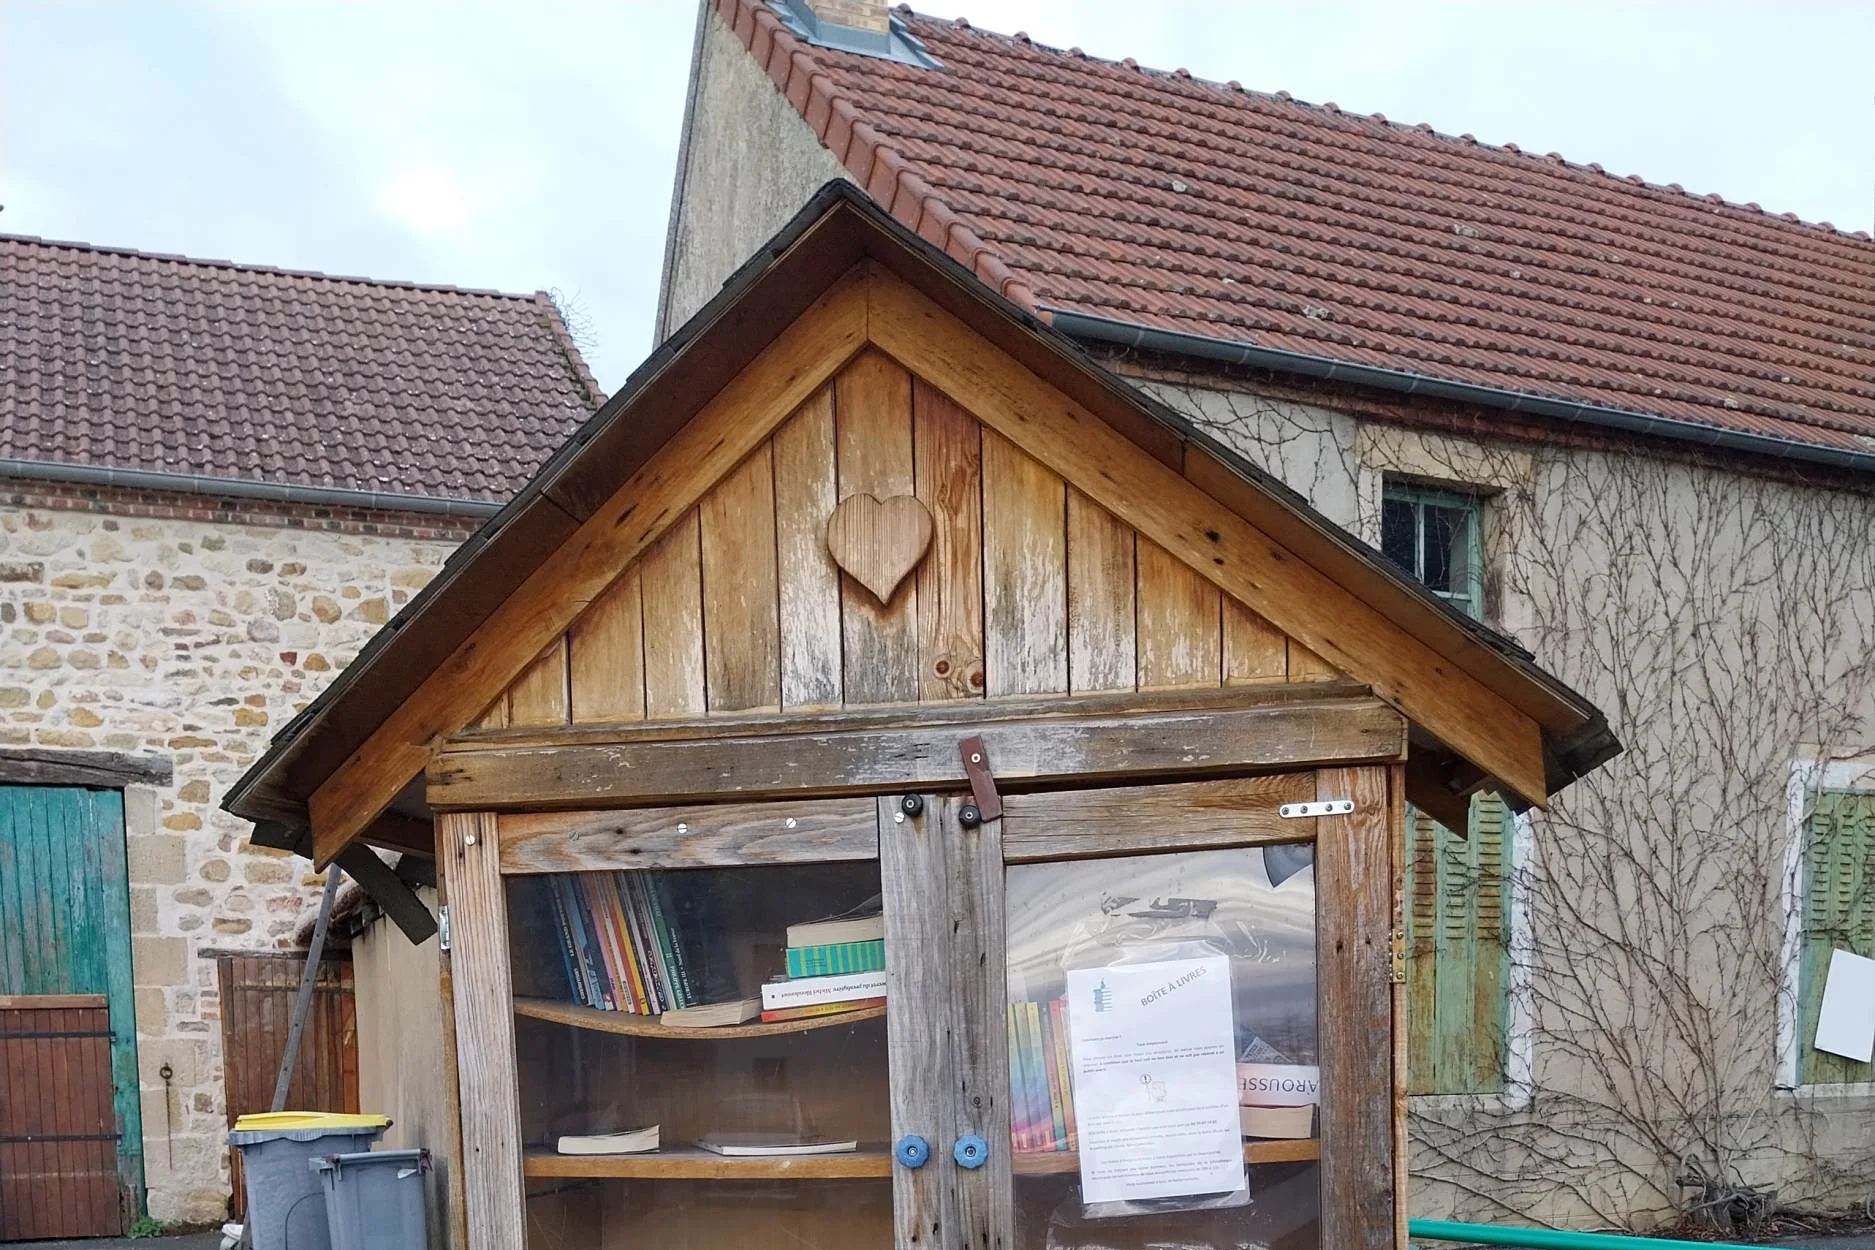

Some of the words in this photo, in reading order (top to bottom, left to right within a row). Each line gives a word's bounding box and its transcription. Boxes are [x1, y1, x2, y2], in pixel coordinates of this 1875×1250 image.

[1140, 988, 1169, 1007] BOÎTE
[1177, 967, 1207, 987] LIVRES
[1238, 1076, 1319, 1094] AROUSSE
